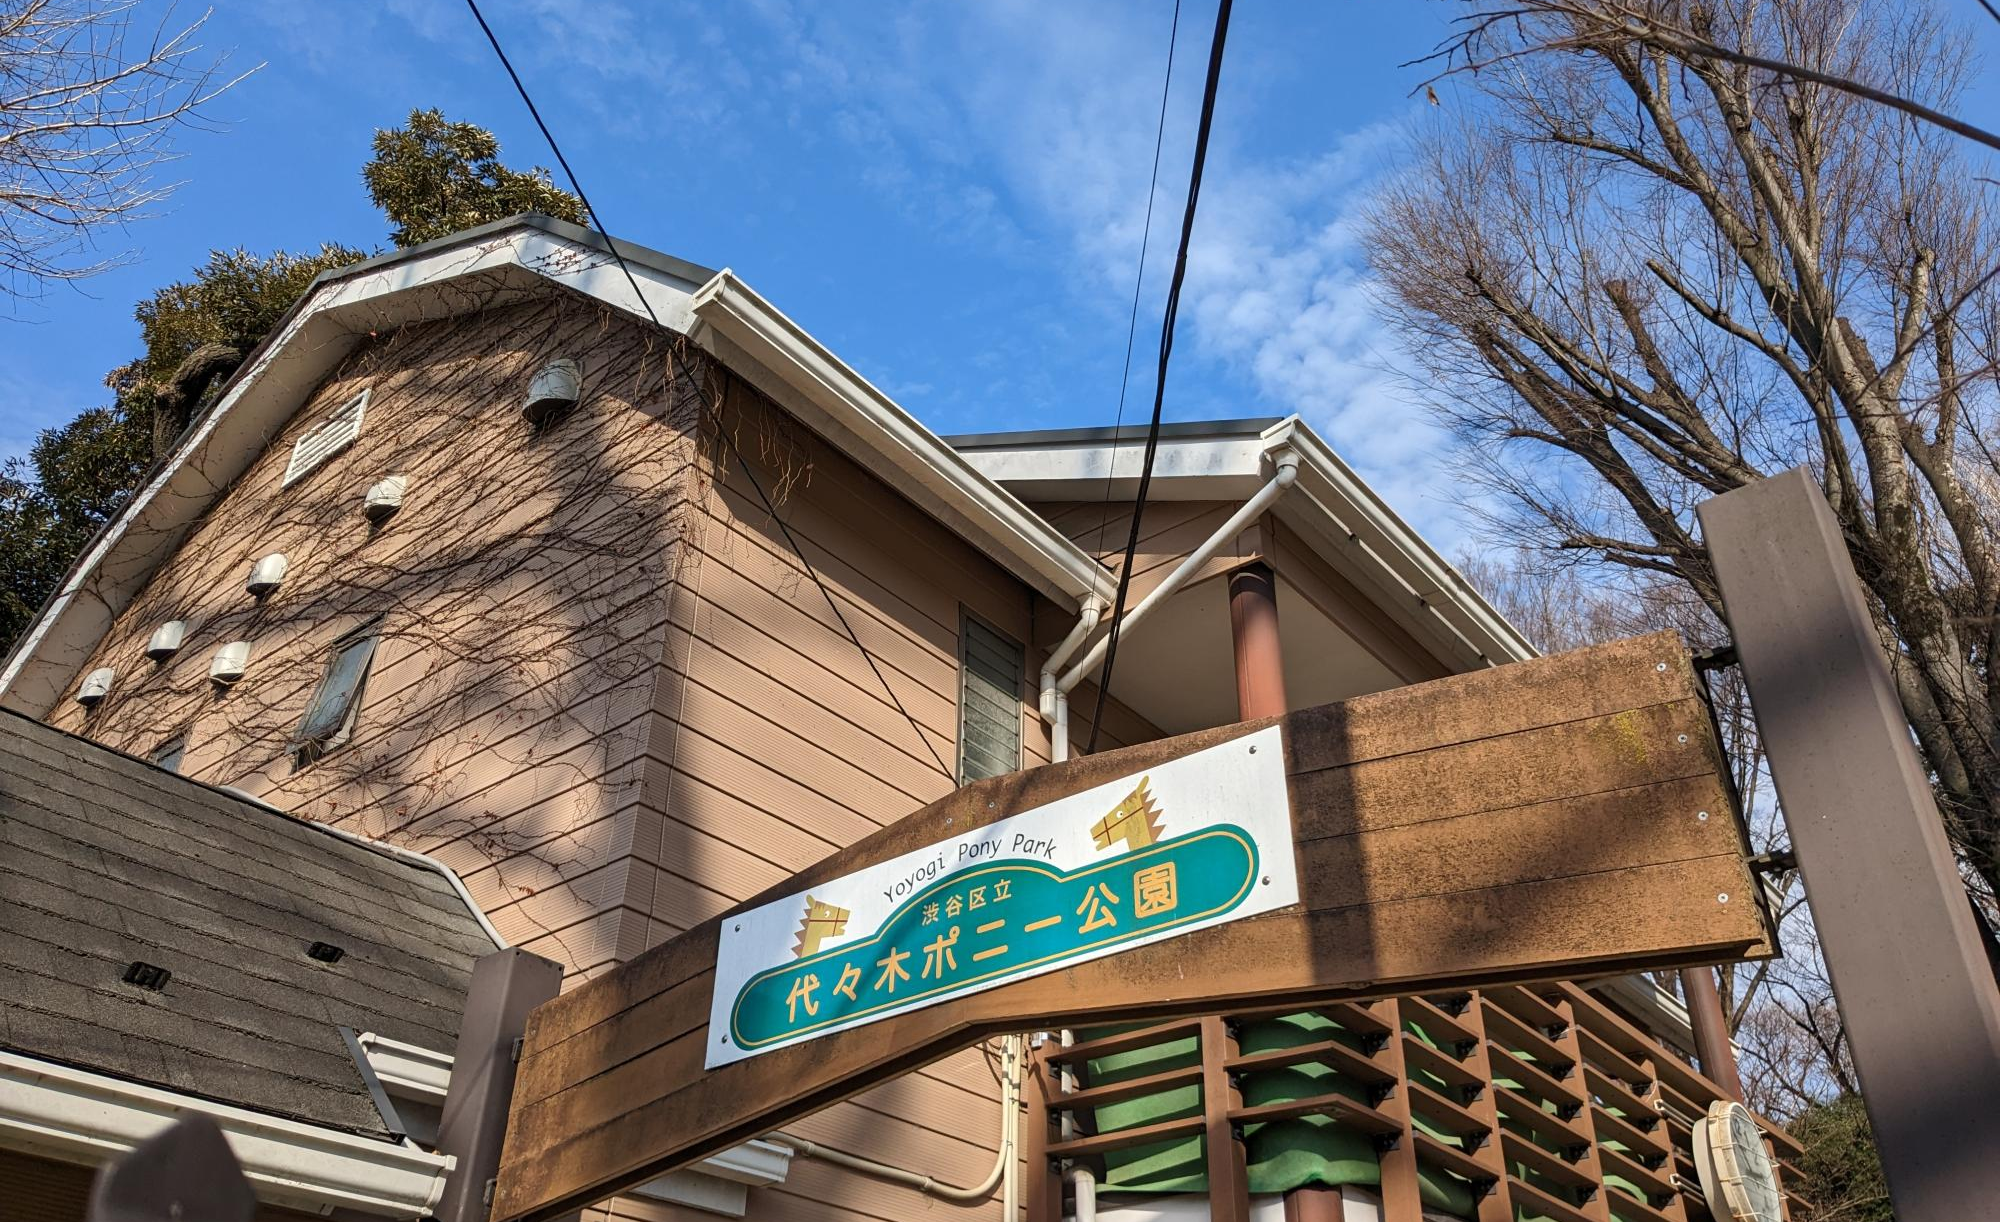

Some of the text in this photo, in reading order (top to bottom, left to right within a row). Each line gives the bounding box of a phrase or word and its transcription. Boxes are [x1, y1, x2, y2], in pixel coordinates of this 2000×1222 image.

[883, 833, 1057, 903] Yoyogi Pony Park
[921, 878, 1012, 926] 渋谷区立
[785, 861, 1178, 1023] 代々木ポニー公園
